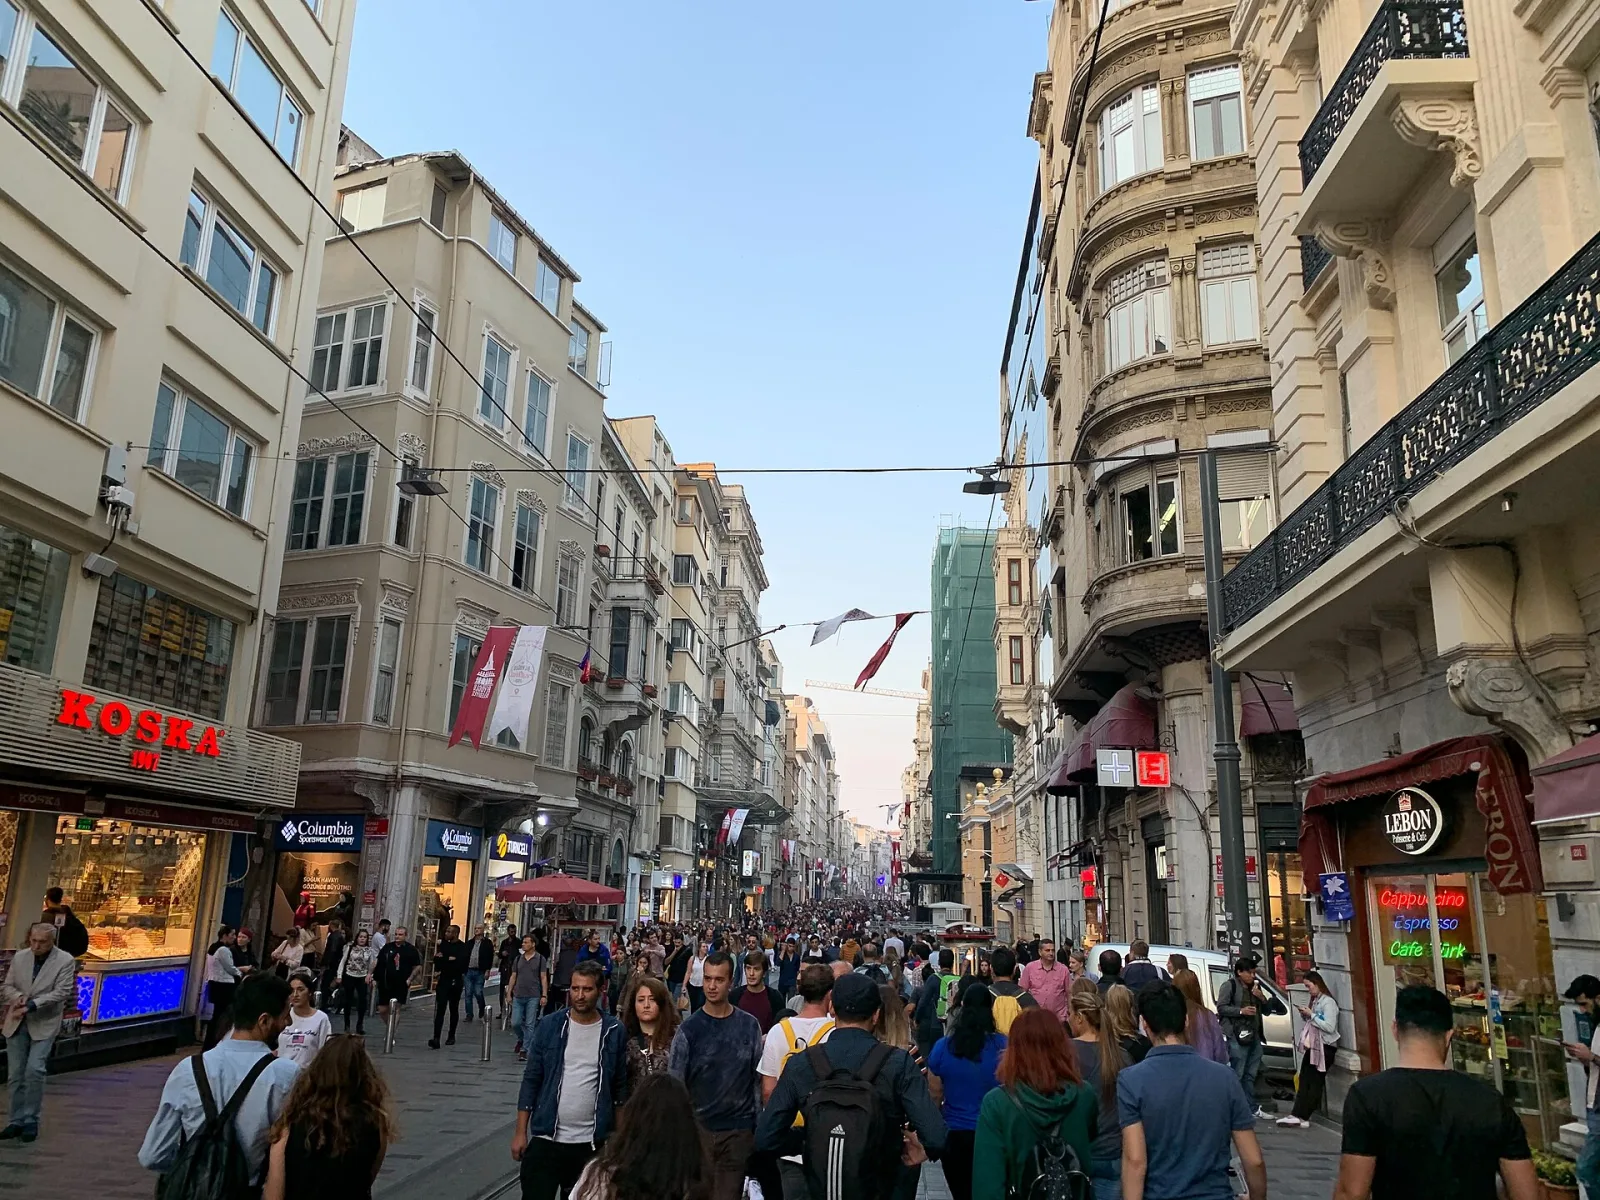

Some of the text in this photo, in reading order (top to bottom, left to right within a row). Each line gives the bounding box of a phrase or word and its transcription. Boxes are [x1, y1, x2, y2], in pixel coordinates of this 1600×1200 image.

[57, 689, 221, 757] KOSKA
[125, 806, 160, 818] KOSKA
[212, 816, 240, 827] KOSKA
[298, 820, 354, 836] Columbia
[1384, 809, 1431, 834] LEBON
[298, 835, 355, 845] Sportswear Company
[449, 829, 473, 845] Columbia
[1411, 832, 1416, 842] &
[1390, 940, 1423, 957] Cafe
